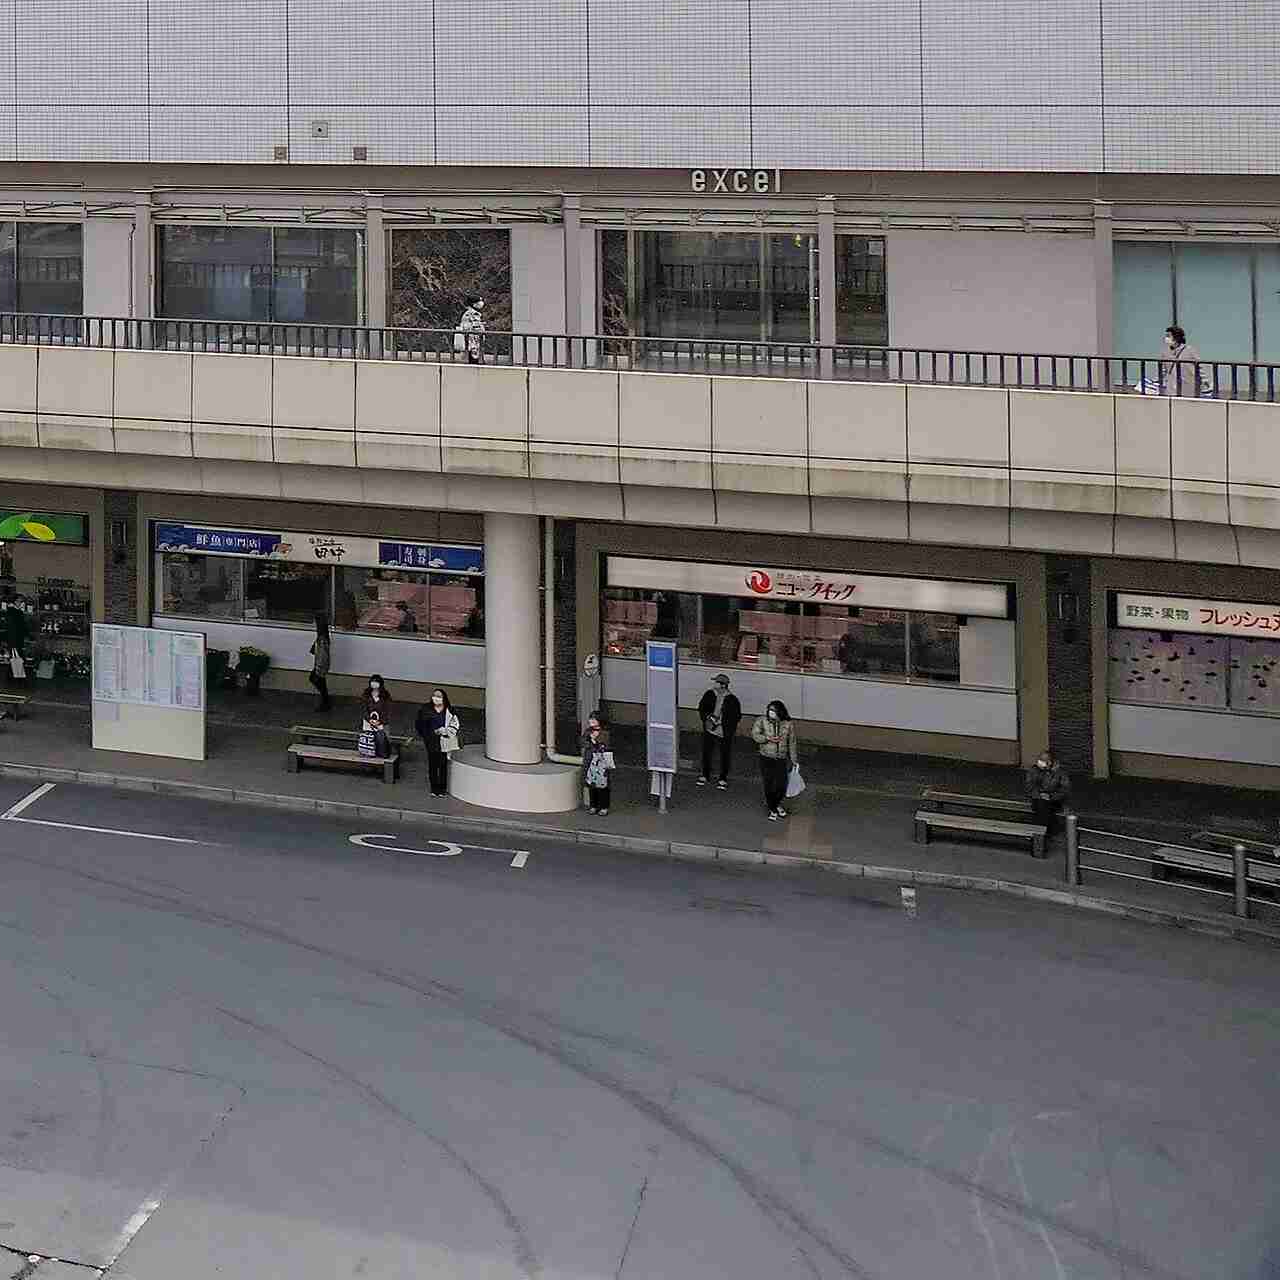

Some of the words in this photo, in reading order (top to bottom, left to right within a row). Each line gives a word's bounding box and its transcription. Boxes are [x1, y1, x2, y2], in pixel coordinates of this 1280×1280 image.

[690, 167, 782, 194] excel
[1125, 605, 1191, 622] 野菜・果物
